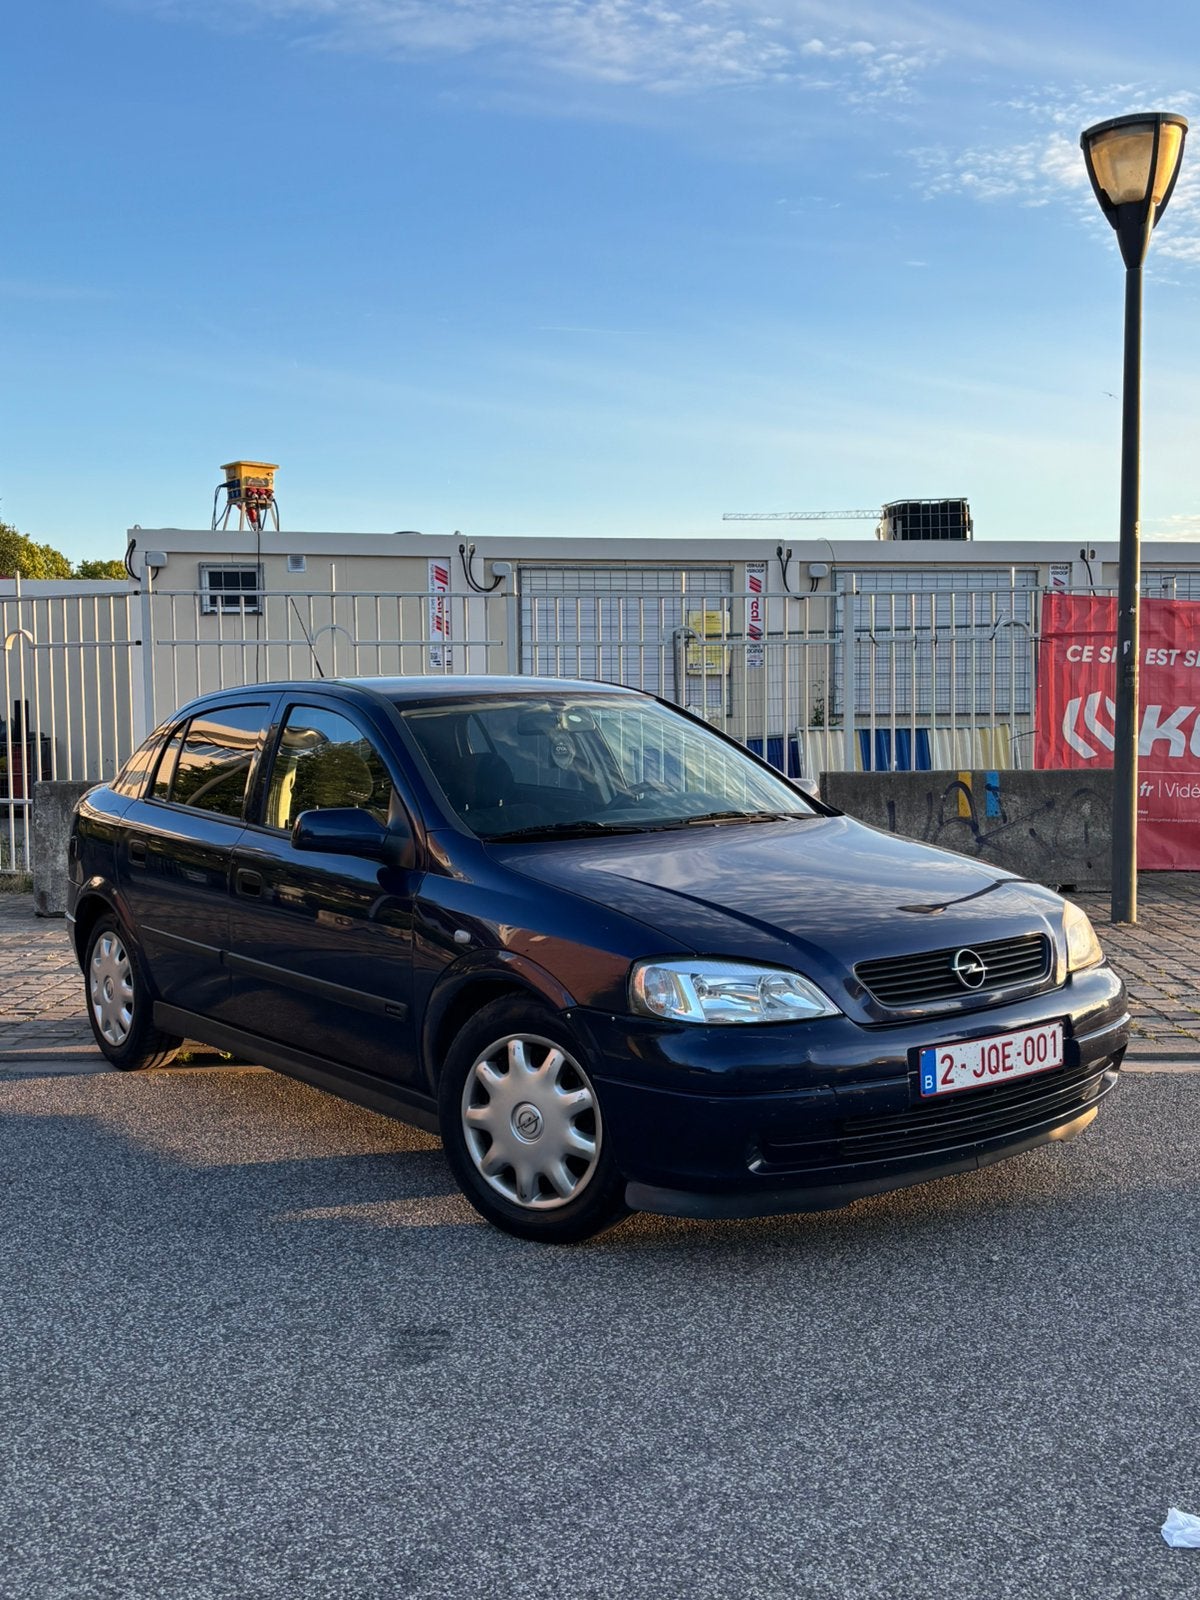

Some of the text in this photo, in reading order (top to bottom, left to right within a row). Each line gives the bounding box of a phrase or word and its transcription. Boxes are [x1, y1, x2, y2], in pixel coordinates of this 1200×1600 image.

[1066, 645, 1094, 662] CE
[1145, 648, 1180, 666] EST
[924, 1075, 933, 1089] B
